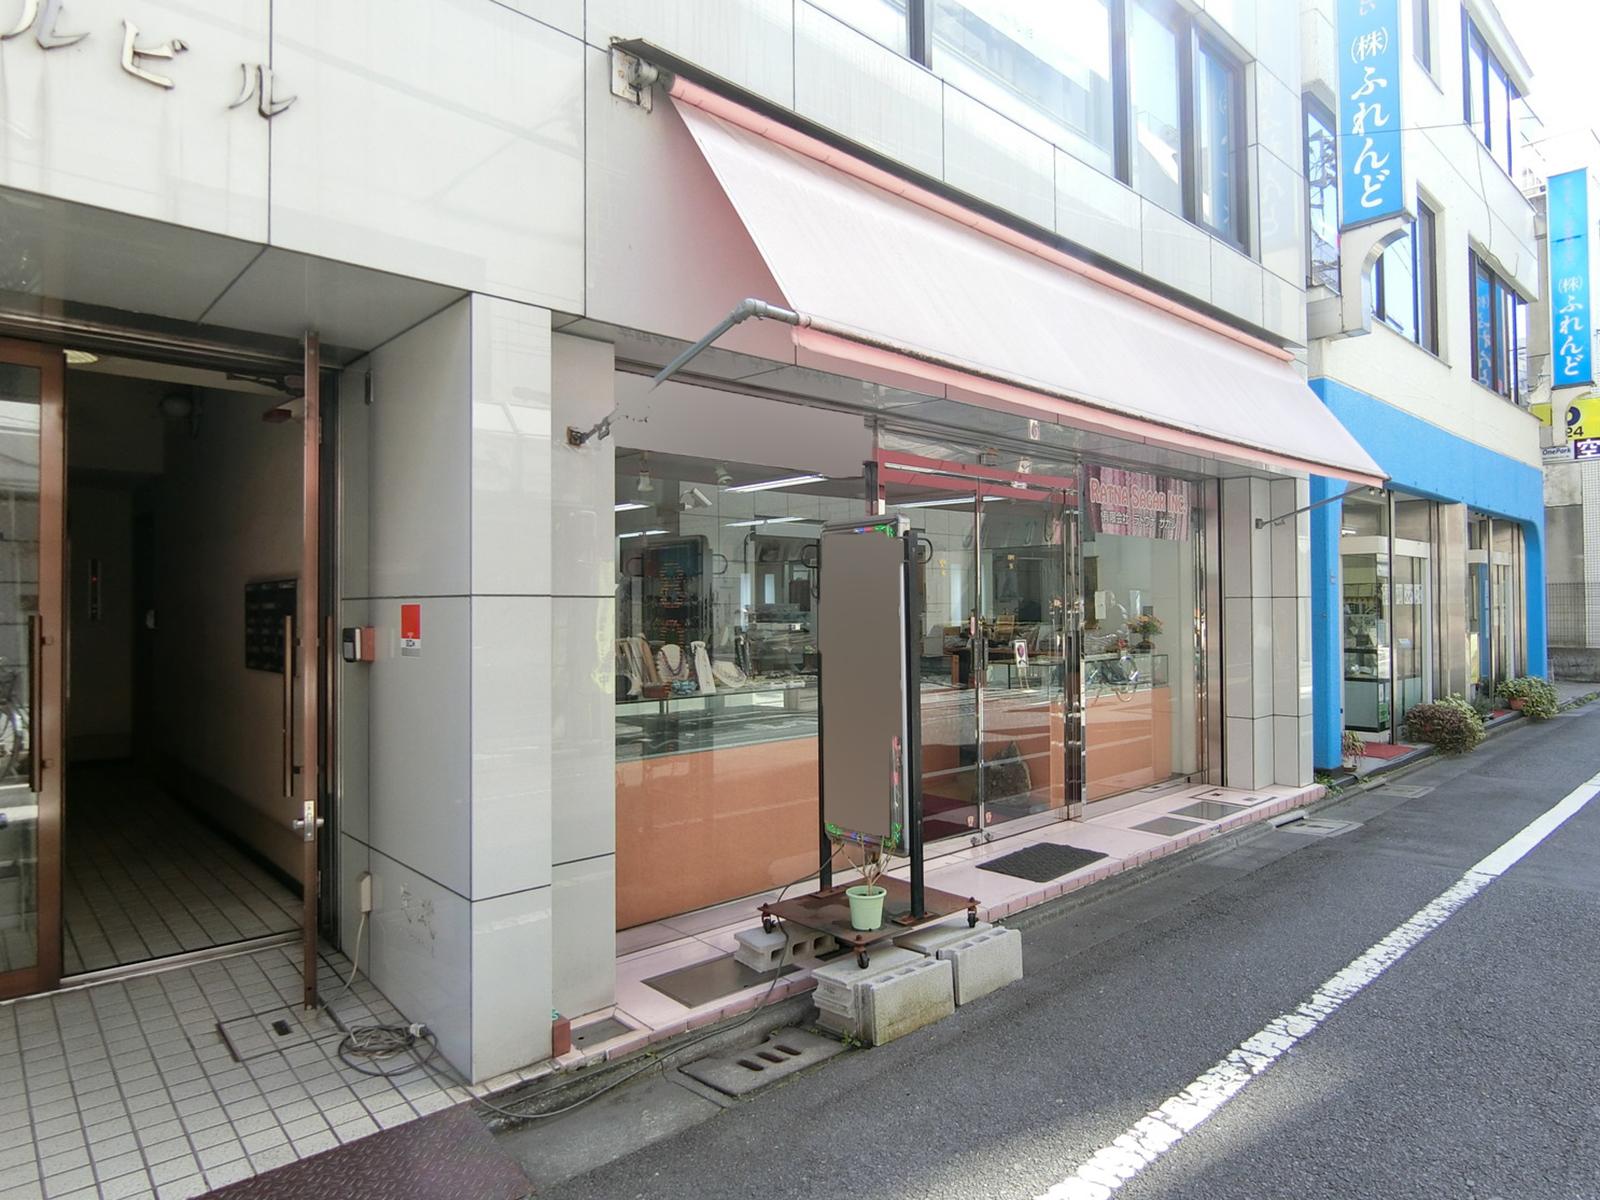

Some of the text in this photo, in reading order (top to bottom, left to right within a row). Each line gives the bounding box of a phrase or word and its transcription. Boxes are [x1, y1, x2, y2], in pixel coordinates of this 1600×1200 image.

[1350, 26, 1390, 209] (株)ふれんど
[1577, 439, 1600, 459] 空
[1101, 511, 1130, 525] 有限会社
